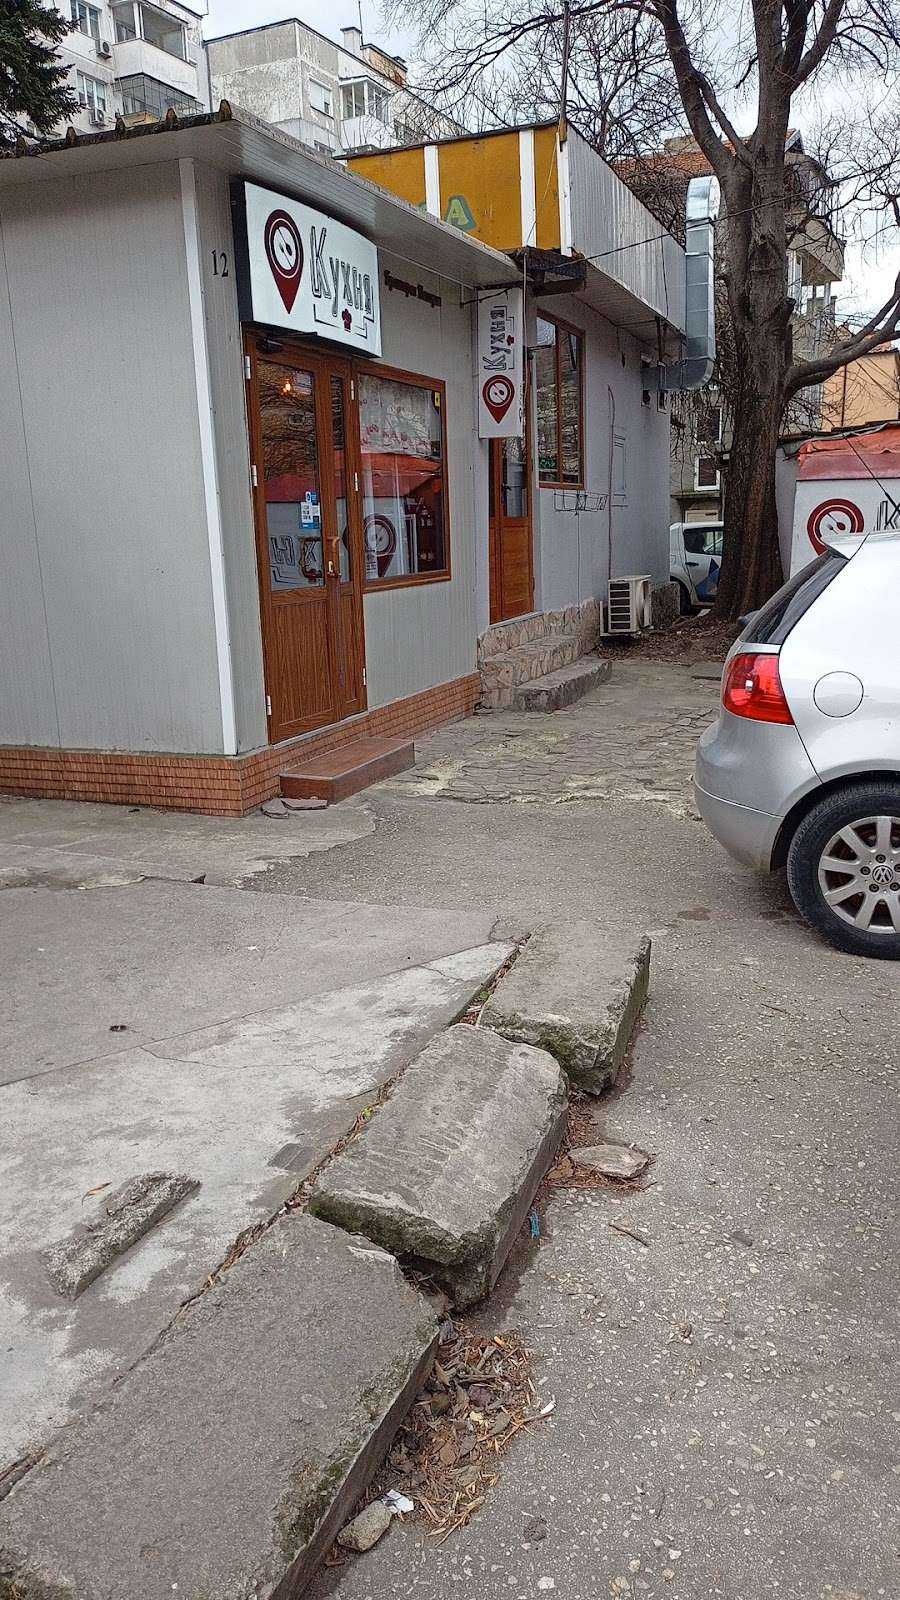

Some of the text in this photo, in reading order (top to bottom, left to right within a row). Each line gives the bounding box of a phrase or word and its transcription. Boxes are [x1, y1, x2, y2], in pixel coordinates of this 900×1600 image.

[211, 249, 229, 278] 12
[309, 225, 373, 318] Кухня
[482, 309, 511, 371] Кухня
